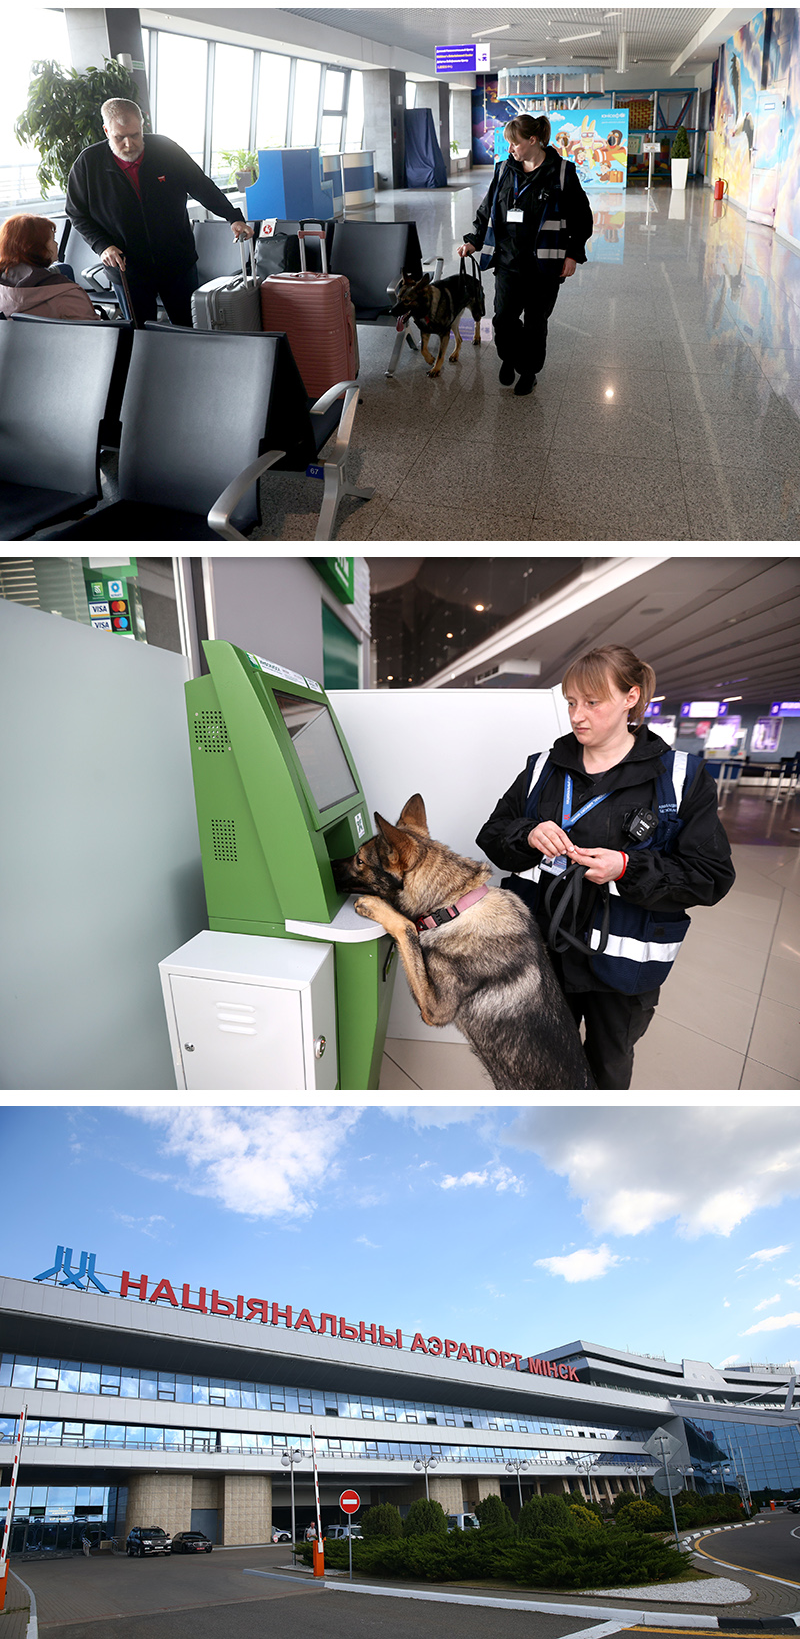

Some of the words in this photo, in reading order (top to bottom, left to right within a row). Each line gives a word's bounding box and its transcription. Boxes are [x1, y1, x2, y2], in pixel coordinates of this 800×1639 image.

[120, 1270, 403, 1349] НАЦЫЯНАЛЬНЫ
[411, 1333, 522, 1371] АЭРАПОРТ
[528, 1357, 580, 1382] МІНСК
